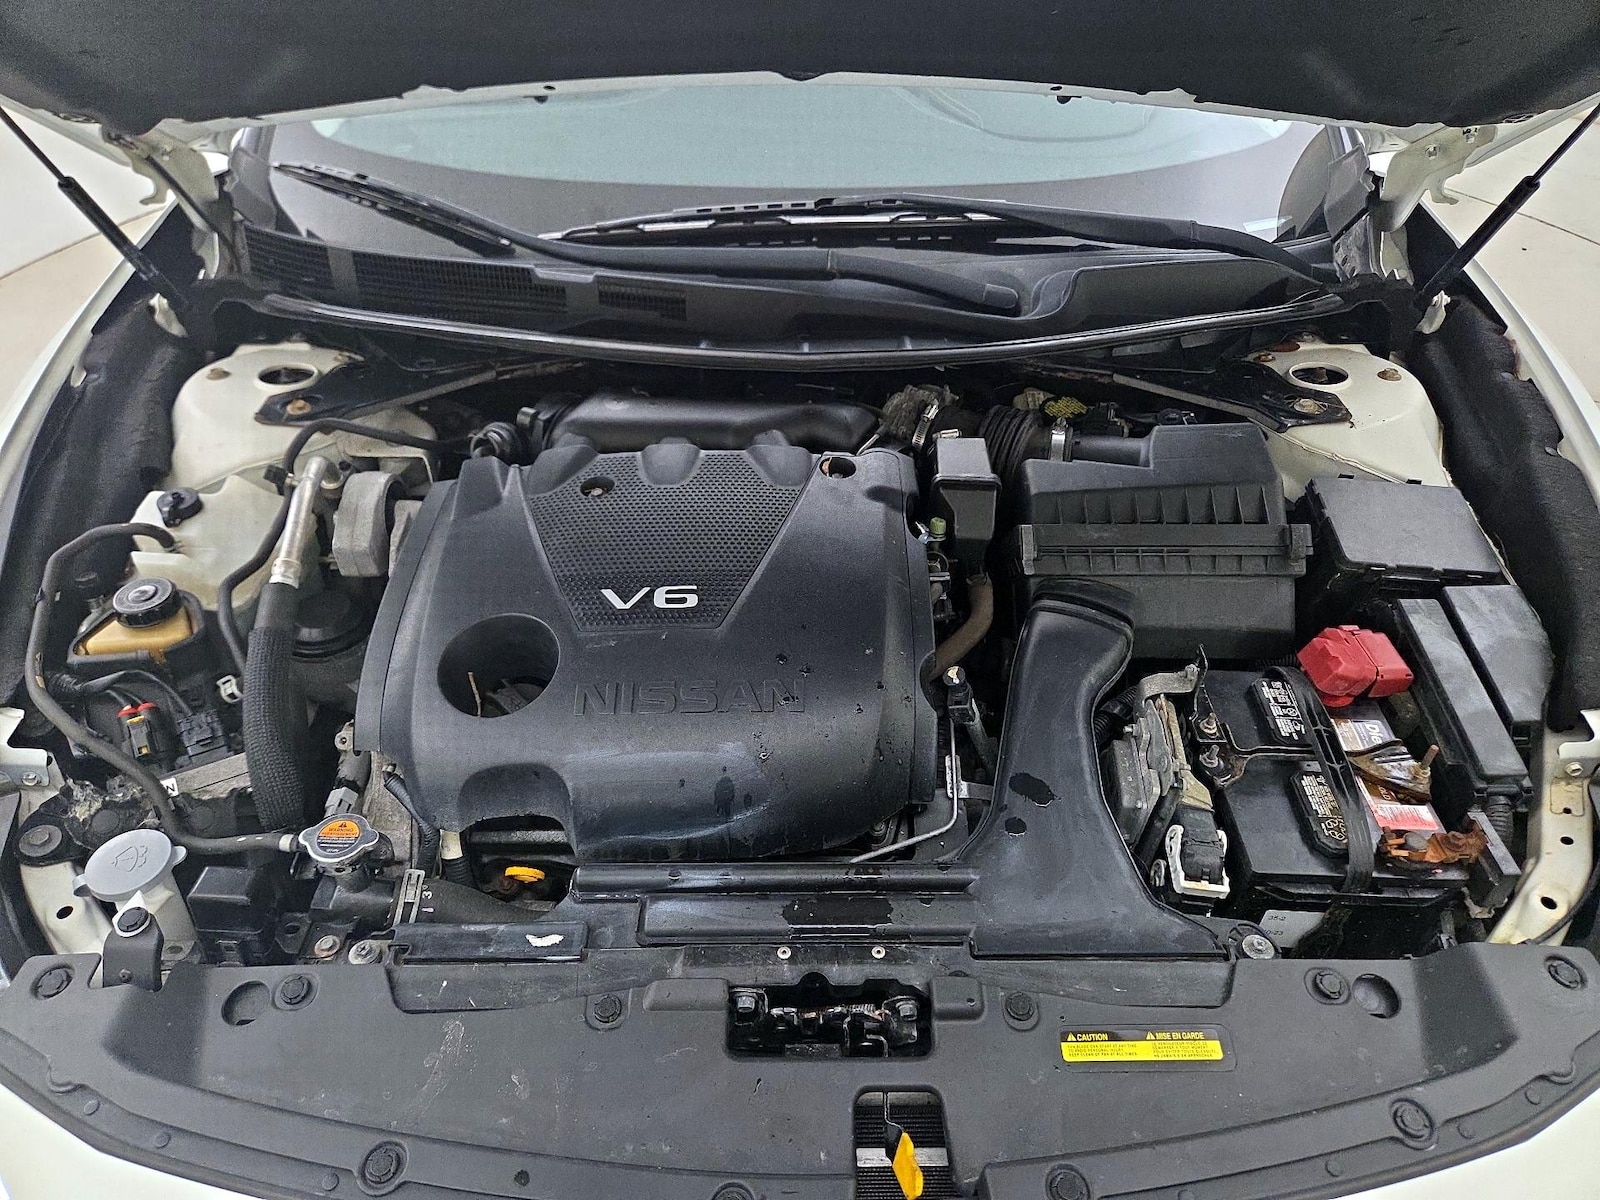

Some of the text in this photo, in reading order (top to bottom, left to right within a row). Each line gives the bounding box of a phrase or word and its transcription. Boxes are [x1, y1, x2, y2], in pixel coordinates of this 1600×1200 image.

[601, 585, 699, 610] V6
[573, 679, 806, 716] NISSAN
[1076, 1033, 1109, 1041] CAUTION
[1155, 1032, 1171, 1040] MISE
